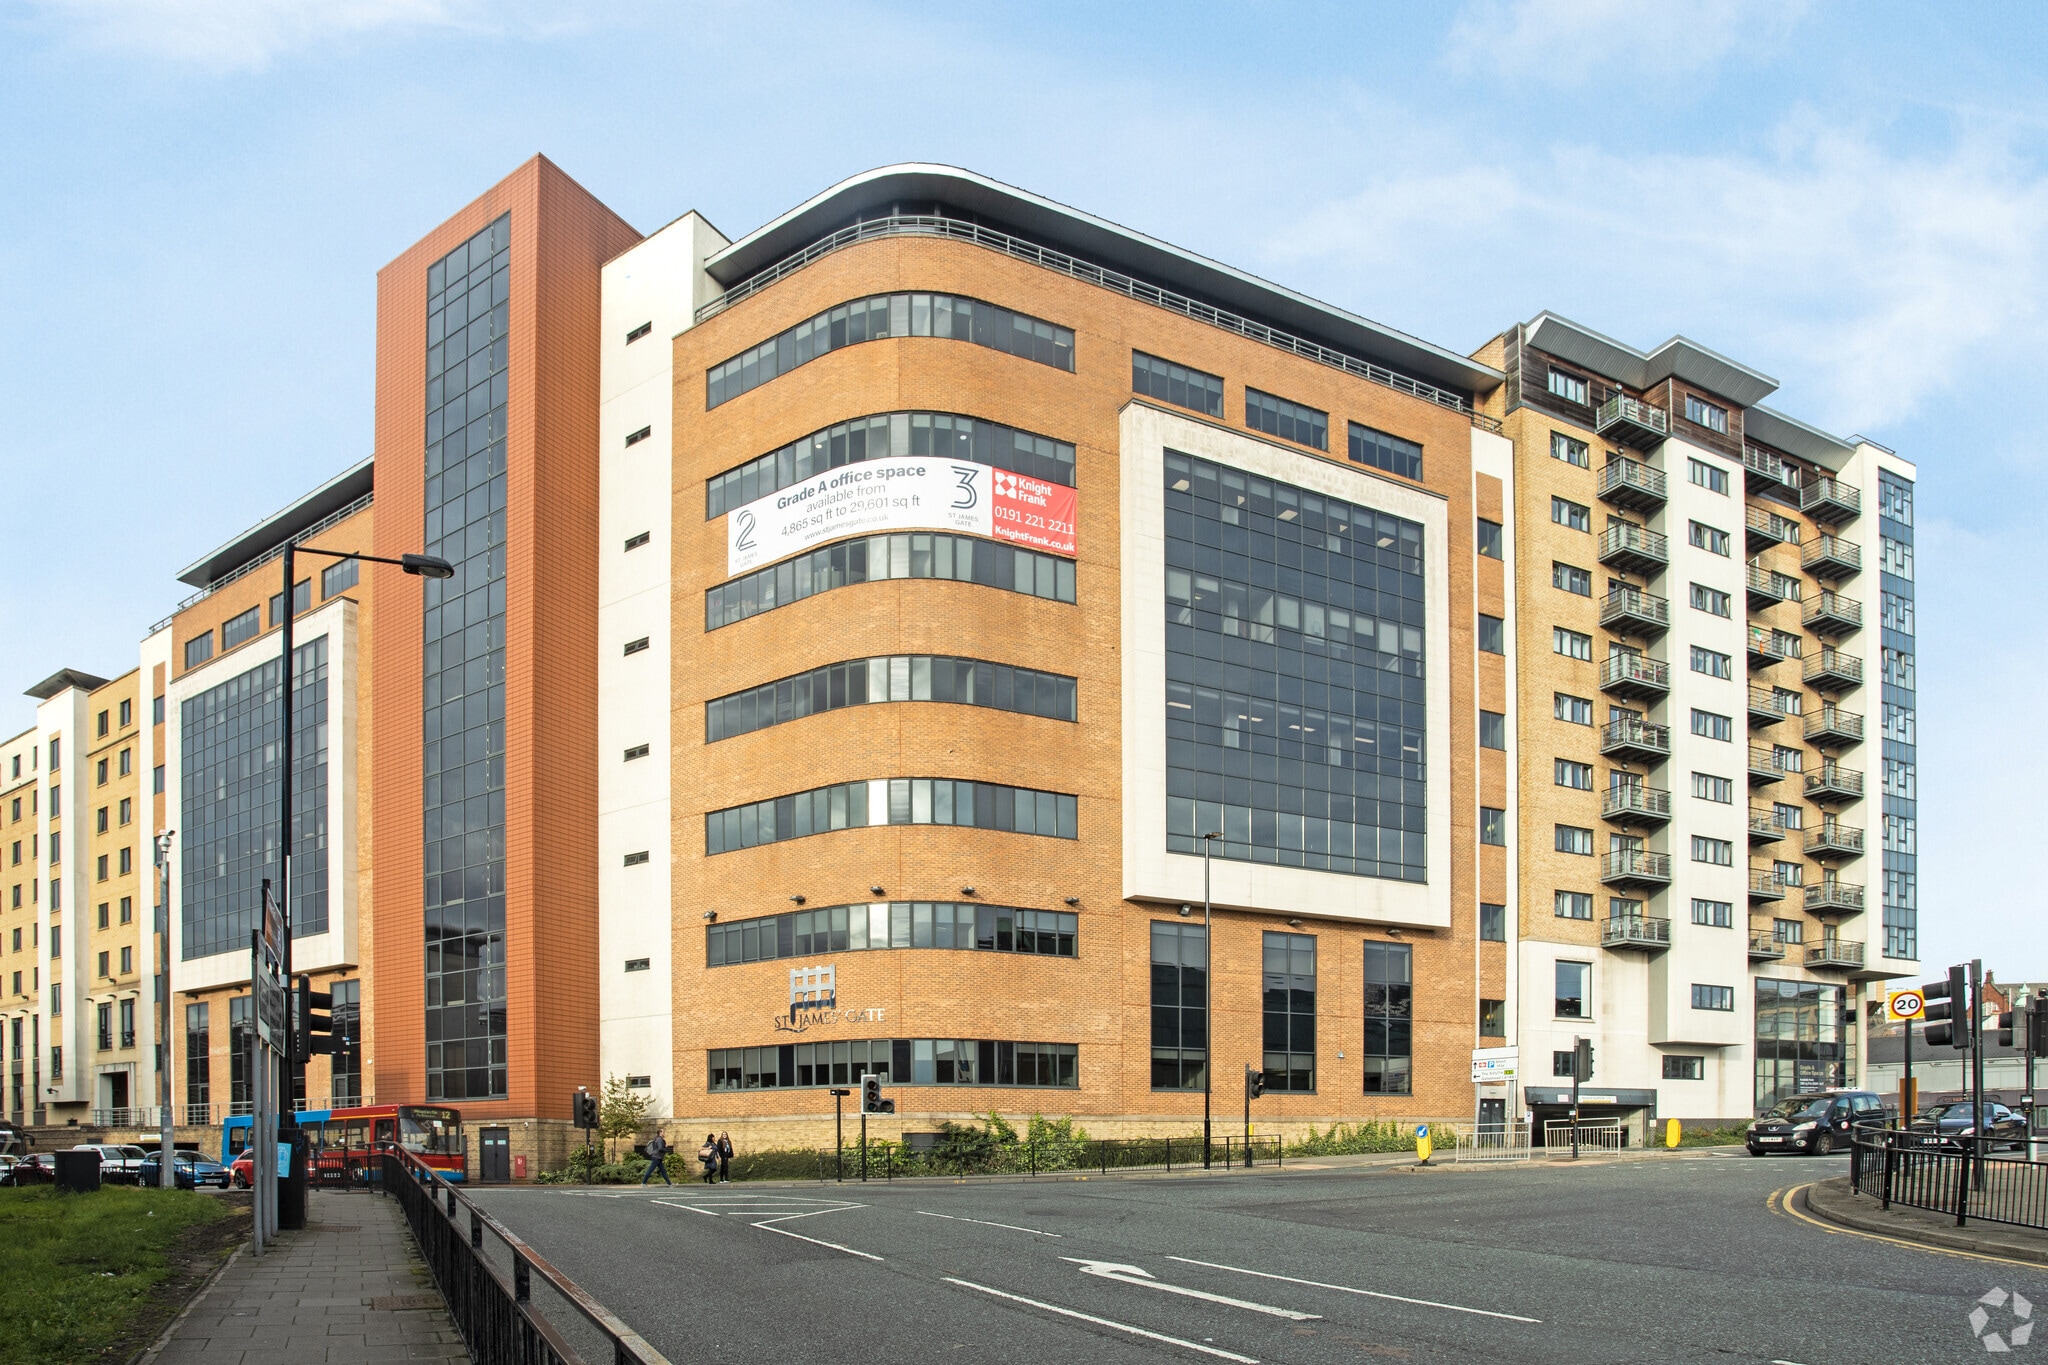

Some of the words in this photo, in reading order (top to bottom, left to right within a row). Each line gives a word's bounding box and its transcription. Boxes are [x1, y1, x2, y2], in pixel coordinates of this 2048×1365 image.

[777, 486, 815, 510] Grade
[818, 480, 828, 493] A
[830, 468, 873, 489] office
[876, 465, 926, 481] space
[950, 465, 979, 509] 3
[1018, 477, 1052, 496] Knight
[806, 488, 853, 513] available
[857, 483, 886, 497] from
[1018, 491, 1047, 507] Frank
[781, 517, 809, 537] 4,865
[810, 514, 823, 525] sq
[825, 508, 833, 520] ft
[836, 505, 847, 516] to
[850, 497, 889, 514] 29,601
[892, 496, 908, 509] sq
[911, 495, 921, 507] ft
[955, 519, 972, 528] GATE
[958, 513, 979, 523] JAMES
[994, 505, 1022, 523] 0191
[1025, 513, 1045, 529] 221
[1048, 519, 1075, 535] 2211
[735, 509, 757, 552] 2
[804, 514, 889, 541] www.stjamesgate.co.uk
[995, 525, 1075, 552] KnightFrank.co.uk
[734, 555, 742, 564] ST
[742, 551, 758, 562] JAMES
[739, 559, 753, 568] GATE
[1897, 999, 1918, 1010] 20
[774, 1015, 790, 1029] ST
[845, 1008, 886, 1023] GATE
[1829, 1064, 1835, 1077] 2
[441, 1111, 451, 1119] 12
